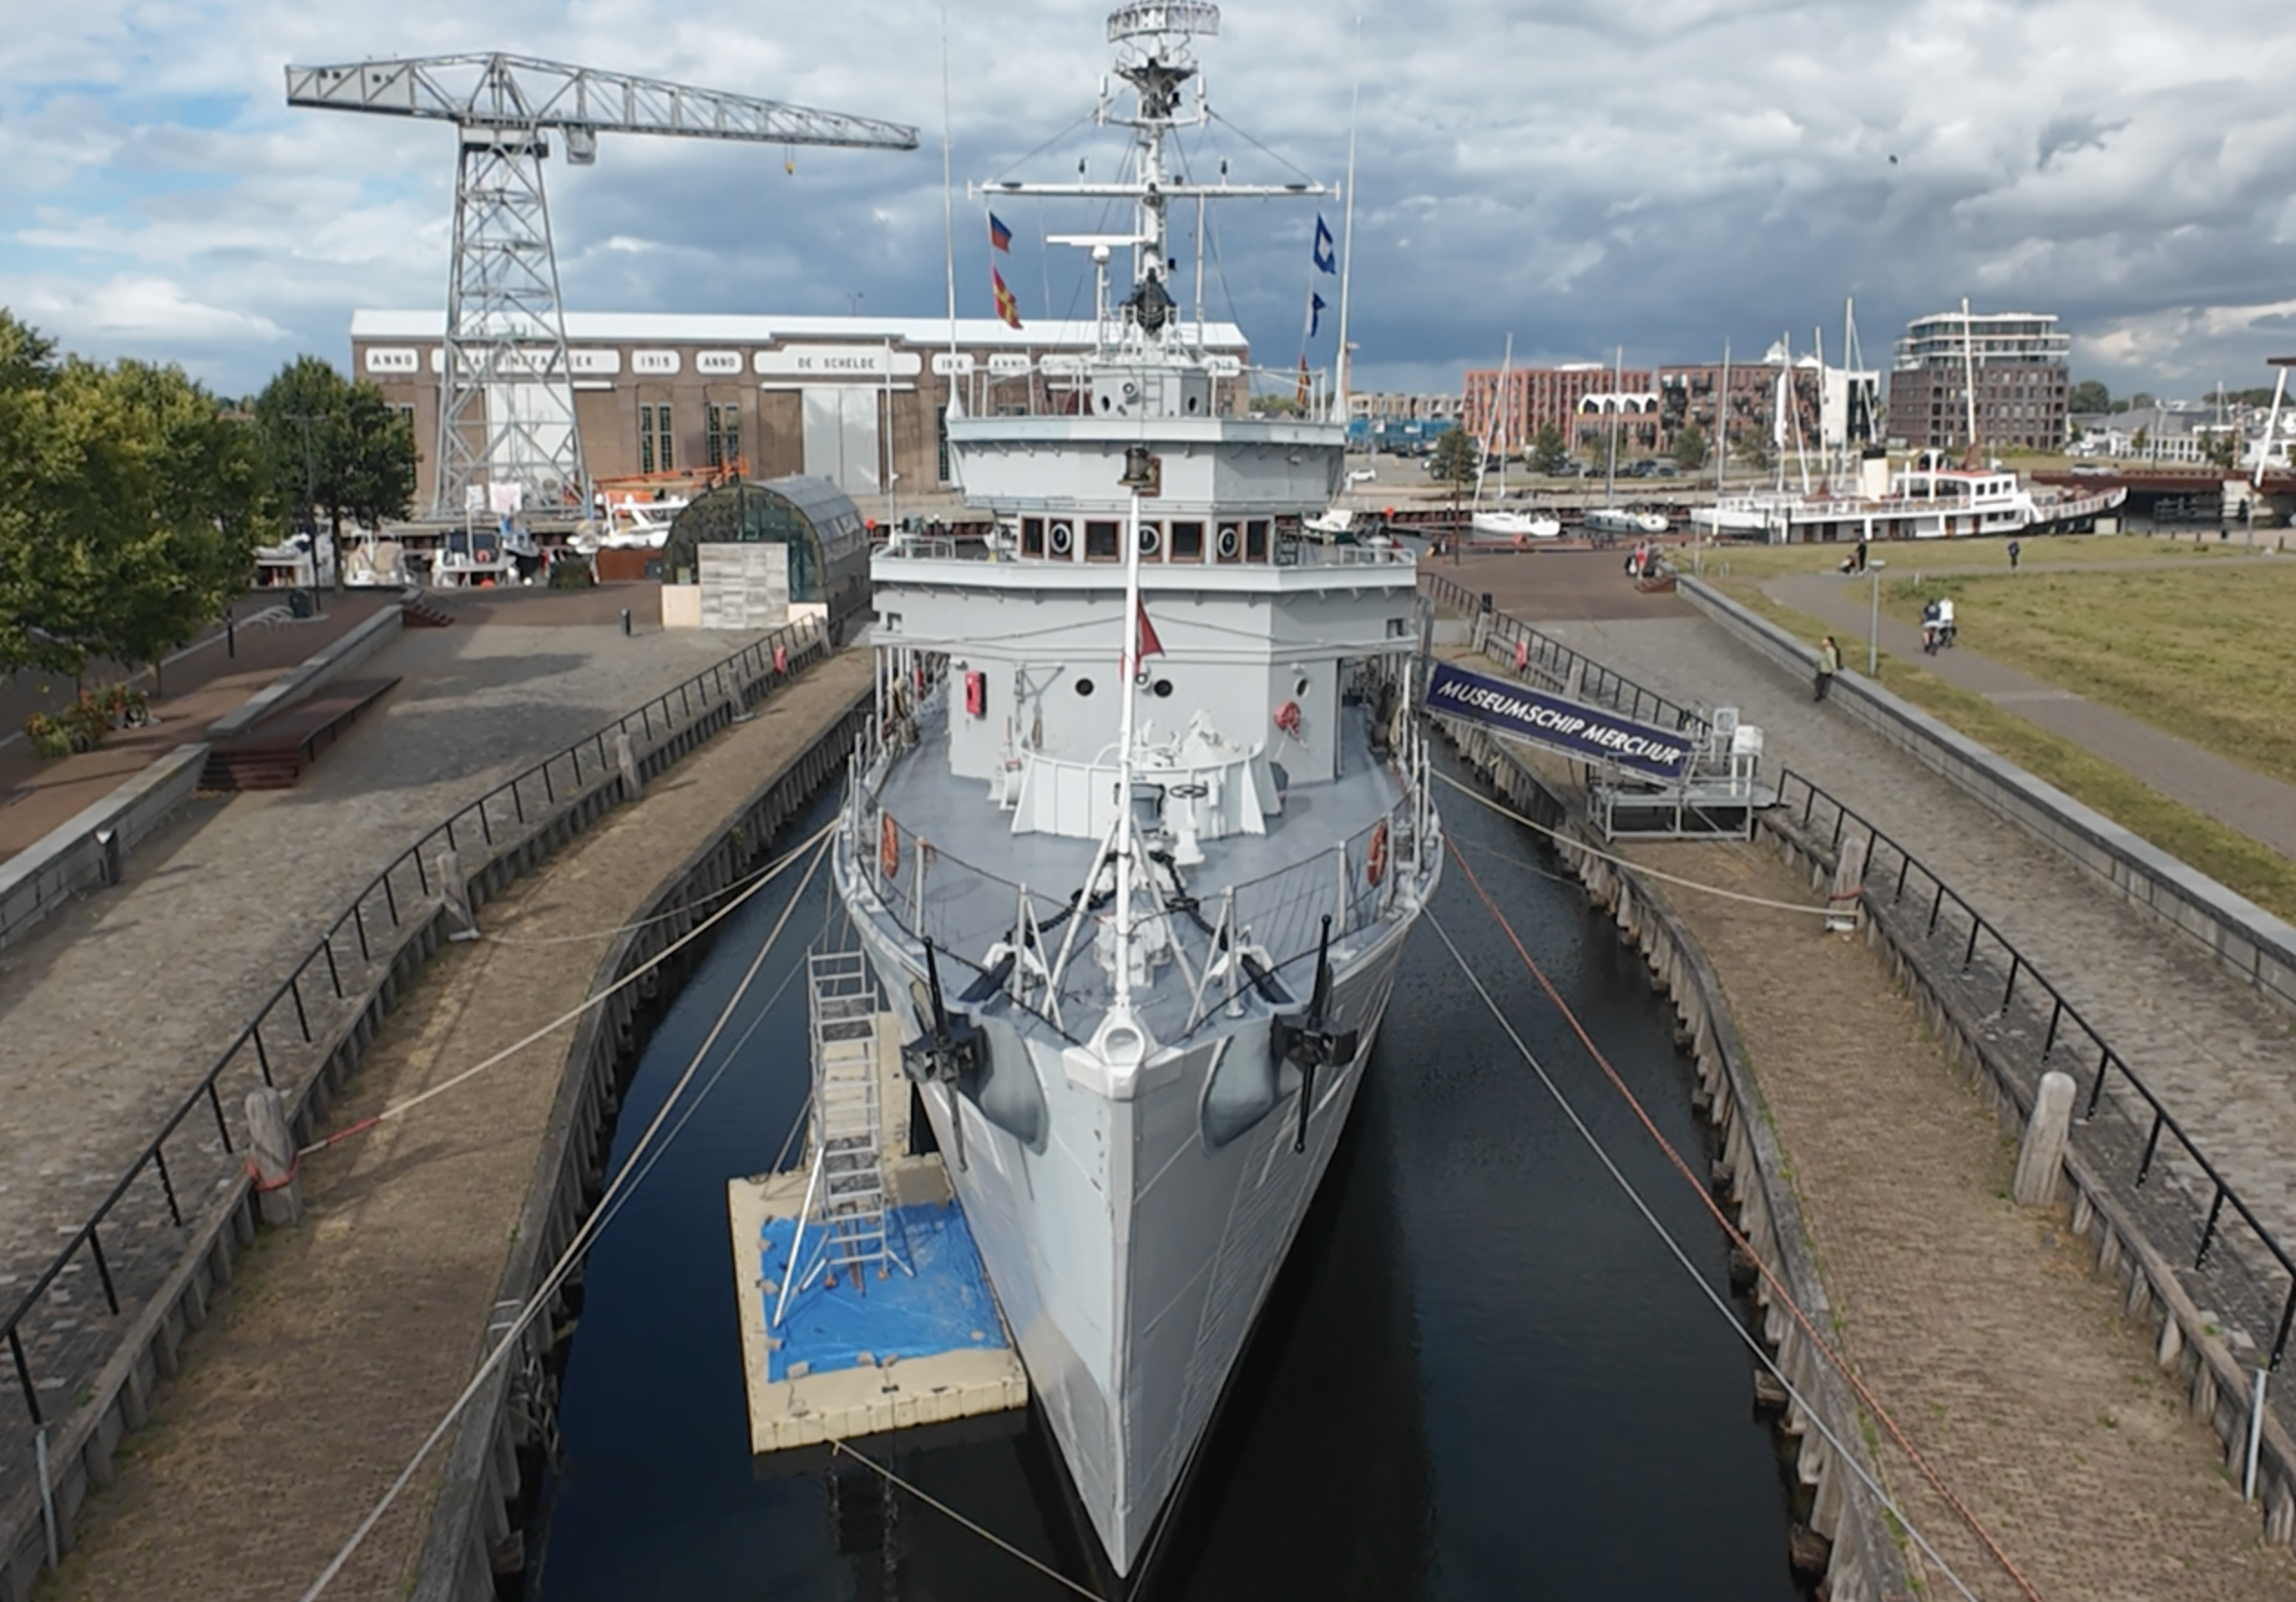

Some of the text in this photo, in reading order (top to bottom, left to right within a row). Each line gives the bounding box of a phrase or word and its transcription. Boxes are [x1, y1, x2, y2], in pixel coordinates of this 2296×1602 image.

[372, 354, 413, 366] ANNO
[703, 357, 736, 367] ANNO
[798, 357, 875, 369] DE SCHELDE
[941, 359, 963, 370] 196
[1437, 680, 1682, 766] MUSEUMSCHIP MERCUUR
